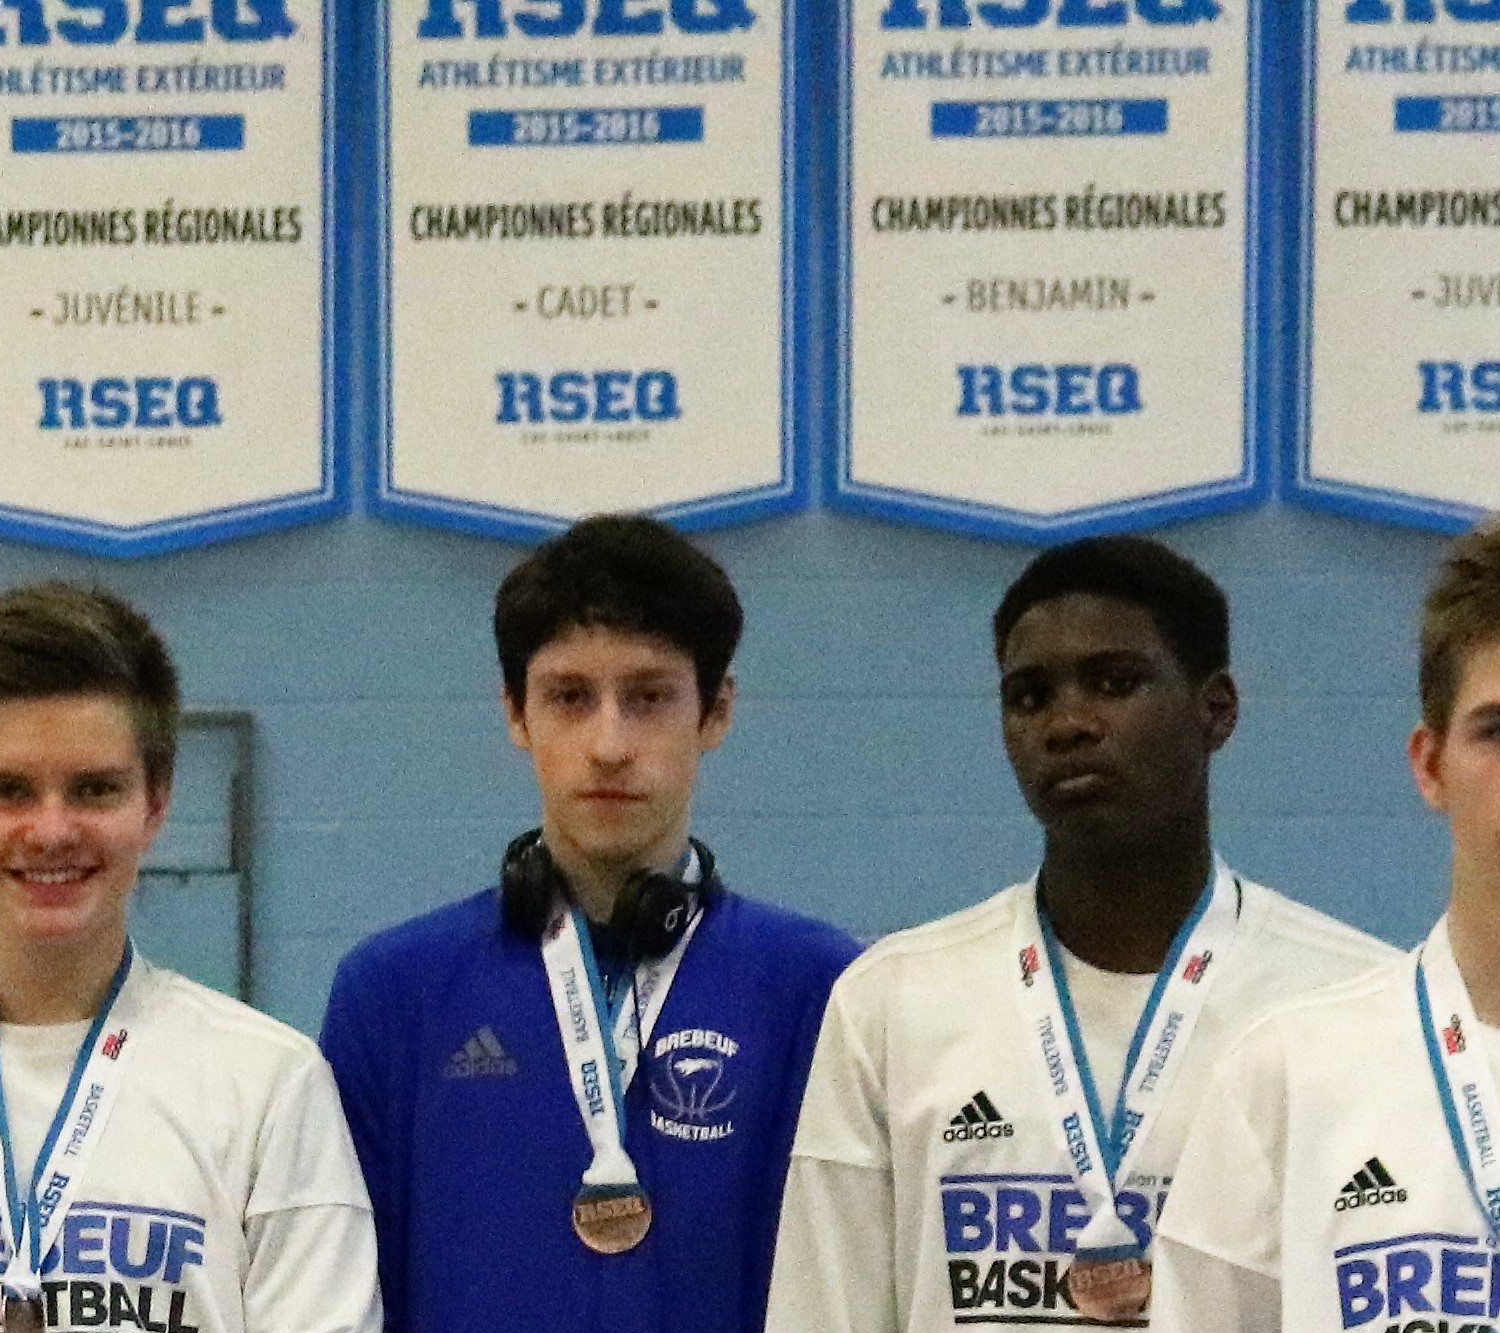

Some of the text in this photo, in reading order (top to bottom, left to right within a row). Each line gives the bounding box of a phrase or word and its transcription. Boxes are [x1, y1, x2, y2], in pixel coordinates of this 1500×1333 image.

[136, 59, 285, 92] EXTÉRIEUR
[419, 53, 744, 87] ATHLÉTISME EXTÉRIEUR
[881, 44, 1210, 78] ATHLÉTISME EXTÉRIEUR
[57, 120, 201, 150] 2015-2016
[513, 111, 658, 142] 2015-2016
[977, 105, 1124, 134] 2015-2016
[144, 198, 302, 244] RÉGIONALES
[411, 192, 762, 240] CHAMPIONNES RÉGIONALES
[872, 184, 1225, 231] CHAMPIONNES RÉGIONALES
[38, 378, 222, 429] RSEQ
[496, 371, 682, 423] RSEQ
[958, 365, 1144, 415] RSEQ
[654, 1028, 739, 1059] BREBEUF
[943, 1123, 1014, 1142] adidas
[1462, 1084, 1497, 1168] BASKETBALL
[1063, 1111, 1092, 1177] RSEQ
[1334, 1188, 1407, 1212] adidas
